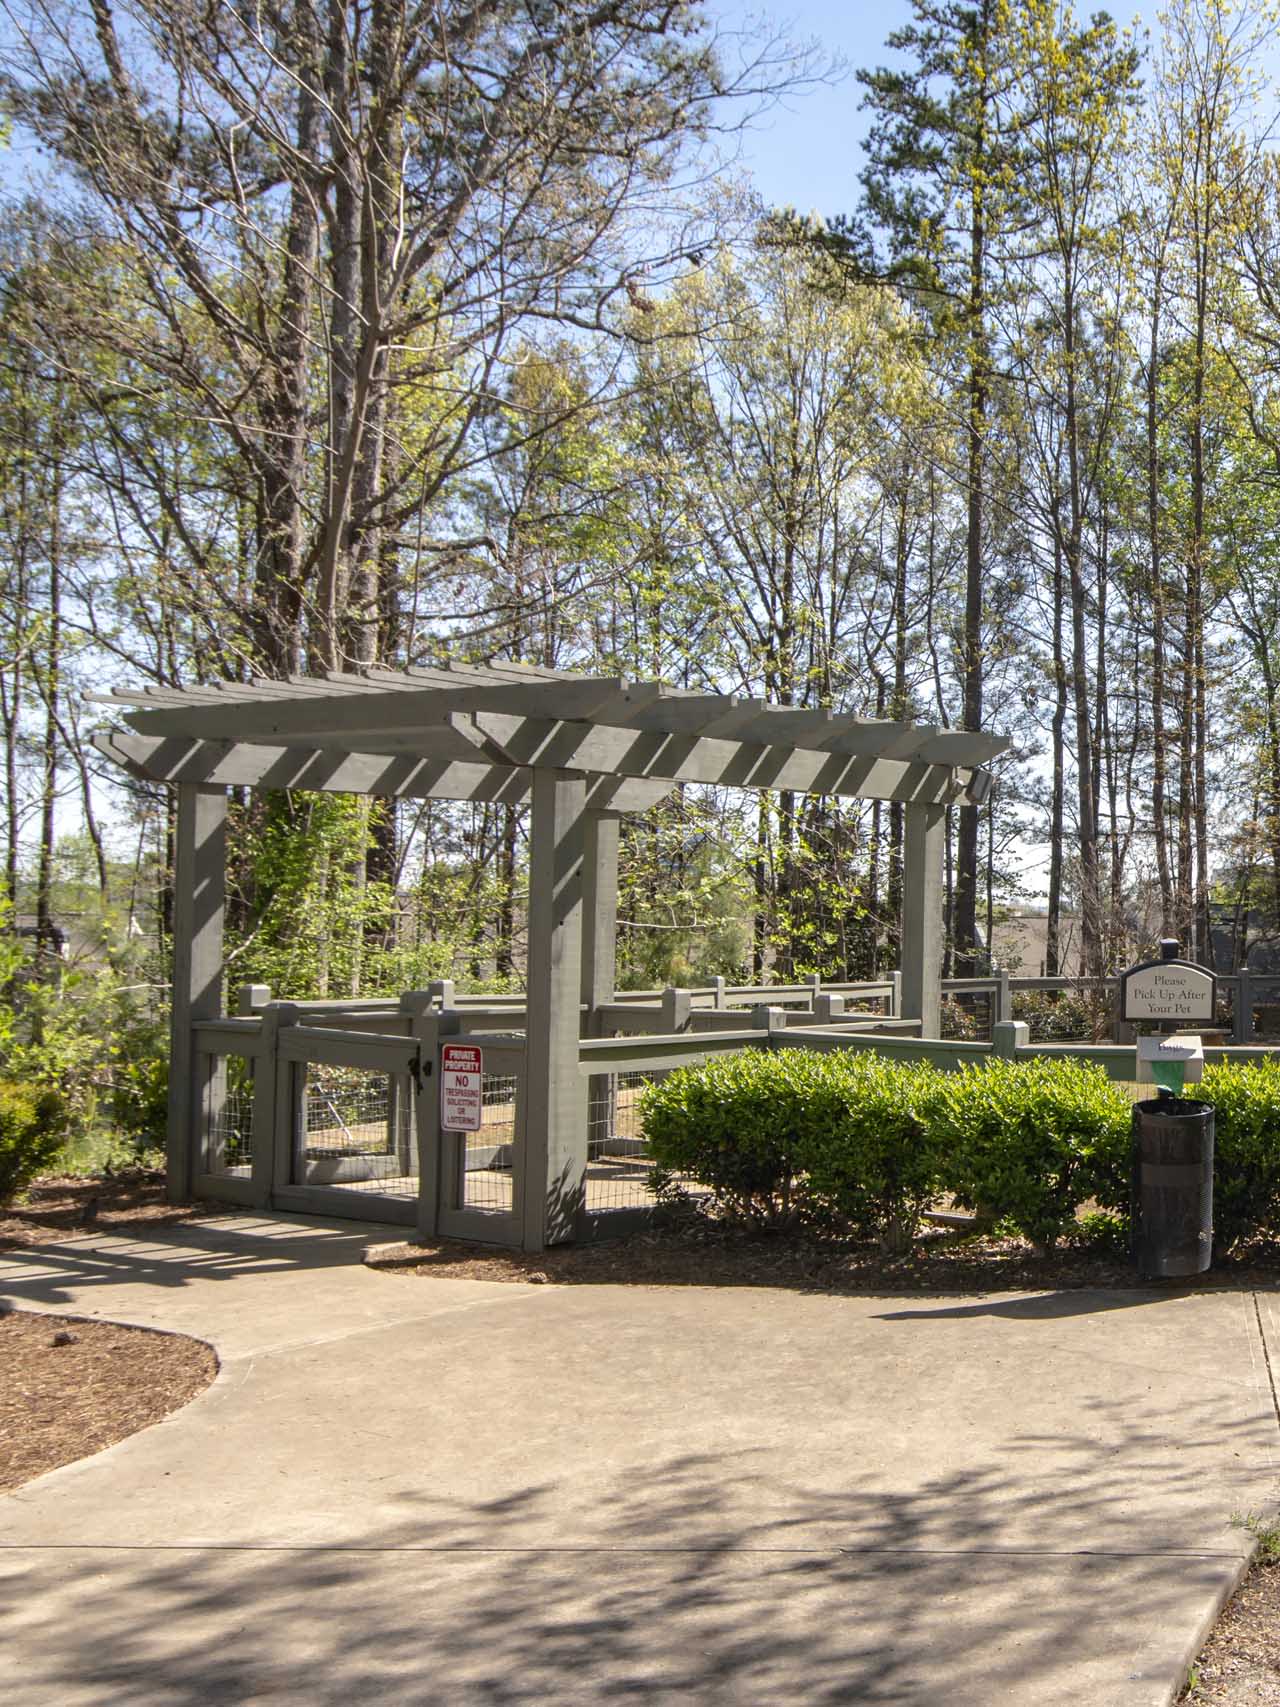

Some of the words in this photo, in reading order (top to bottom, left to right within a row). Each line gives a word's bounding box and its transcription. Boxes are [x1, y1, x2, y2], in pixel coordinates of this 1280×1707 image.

[1154, 975, 1186, 986] Please
[1134, 989, 1156, 1000] Pick
[1160, 989, 1175, 1002] Up
[1178, 989, 1206, 1000] After
[1148, 1003, 1172, 1013] Your
[1175, 1003, 1191, 1014] Pet
[449, 1050, 476, 1061] PRIVATE
[445, 1061, 480, 1072] PROPERTY
[455, 1075, 469, 1087] NO
